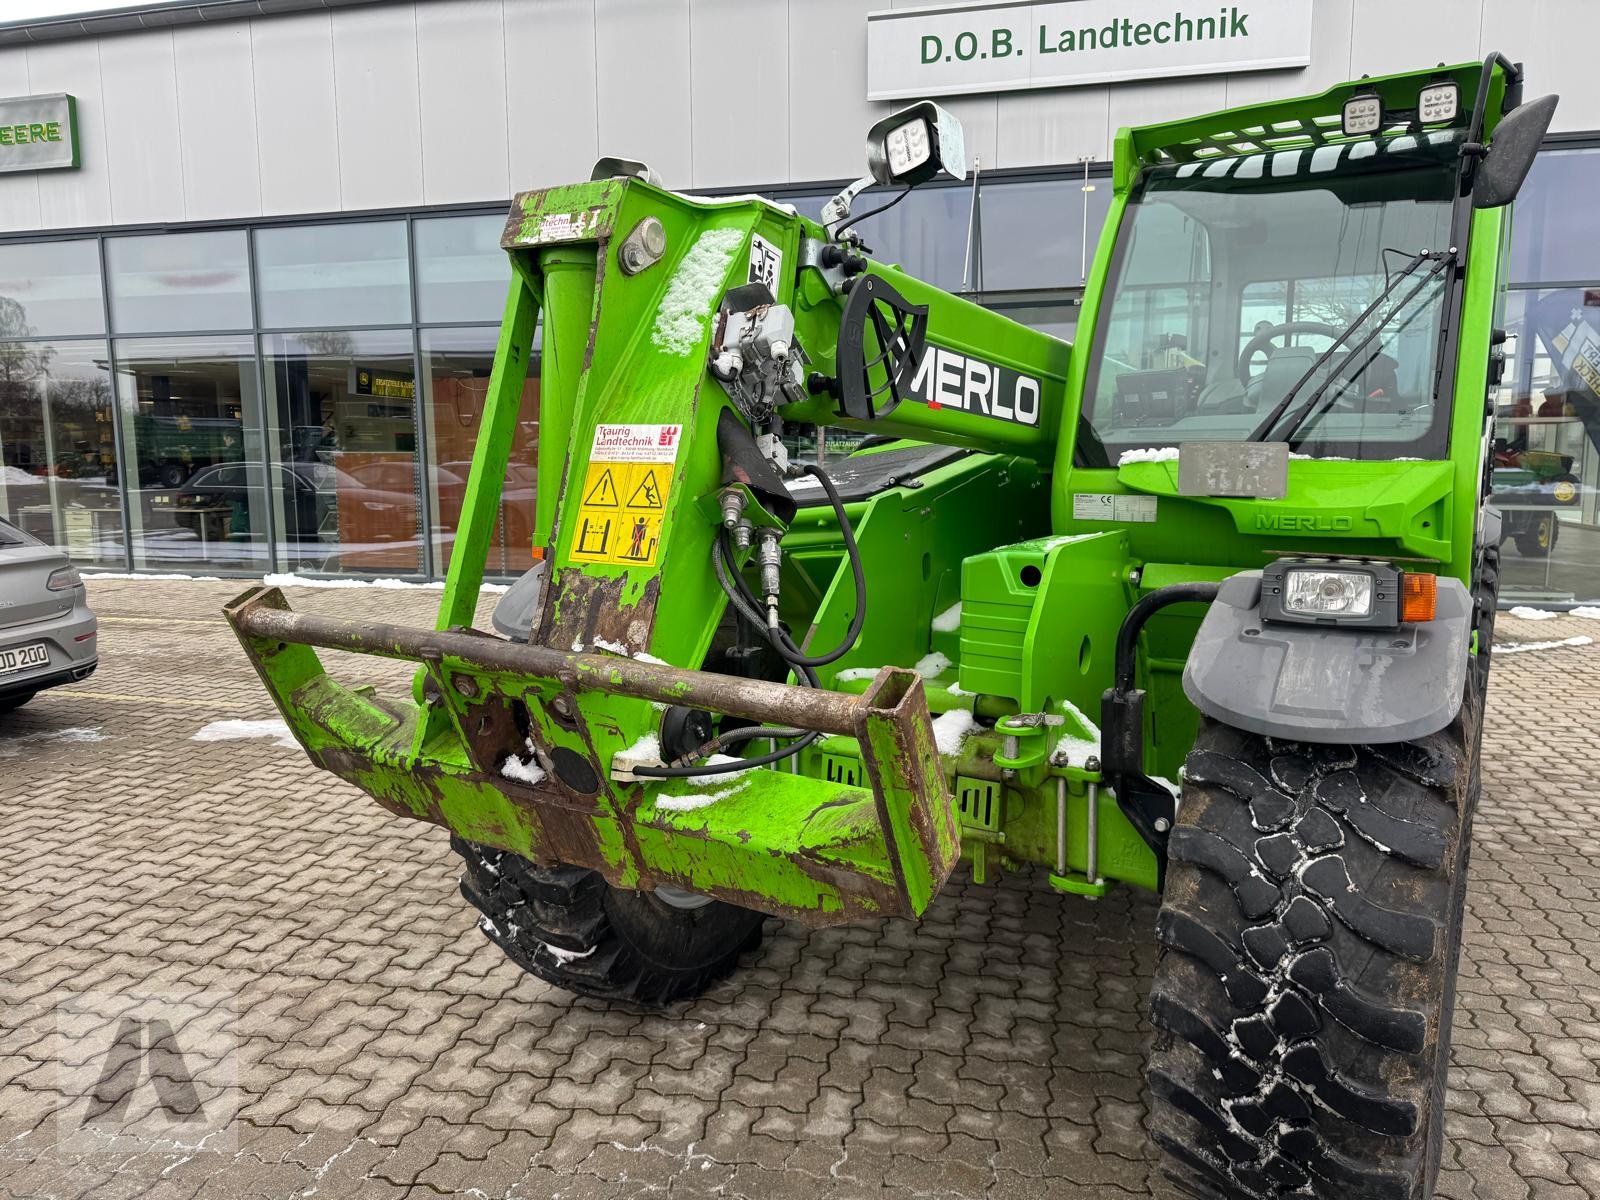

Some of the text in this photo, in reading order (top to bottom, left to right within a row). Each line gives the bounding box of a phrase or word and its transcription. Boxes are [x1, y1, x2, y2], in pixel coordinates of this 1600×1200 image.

[920, 7, 1249, 64] D.O.B. Landtechnik
[896, 337, 1040, 424] MERLO
[596, 436, 654, 446] Landtechnik
[1256, 514, 1353, 531] MERLO
[18, 646, 47, 665] 200
